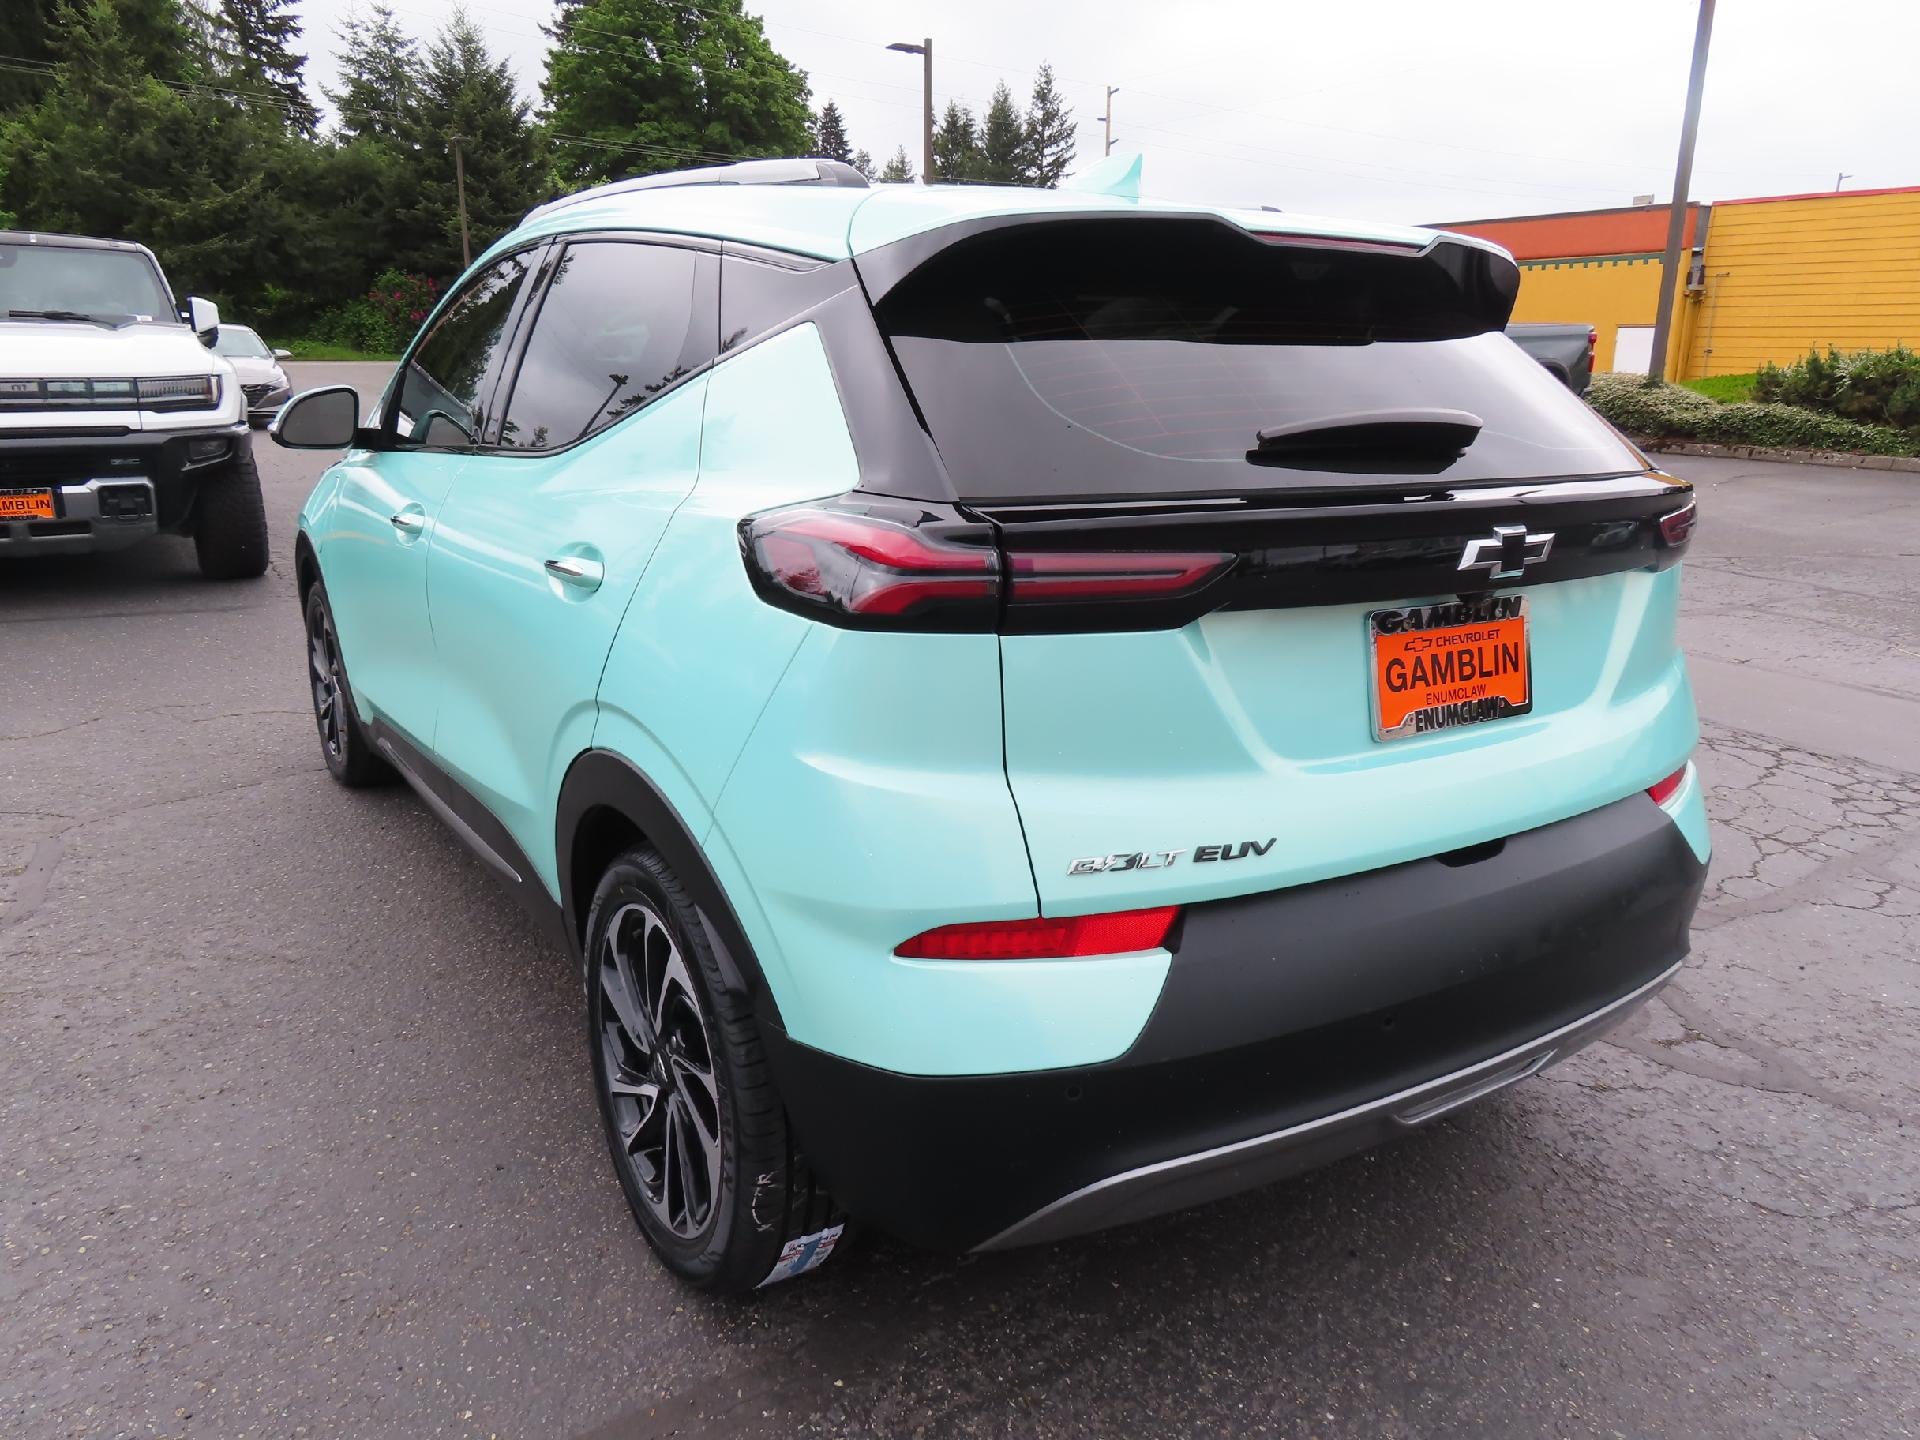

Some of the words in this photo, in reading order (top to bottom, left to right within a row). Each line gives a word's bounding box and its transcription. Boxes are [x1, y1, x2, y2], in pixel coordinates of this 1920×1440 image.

[0, 499, 51, 511] MBLIN
[1436, 629, 1500, 647] CHEVROLET
[1385, 642, 1519, 692] GAMBLIN
[1426, 684, 1486, 705] ENUMCLAW
[1415, 697, 1500, 732] ENUMCLAW
[1192, 837, 1278, 863] EUV
